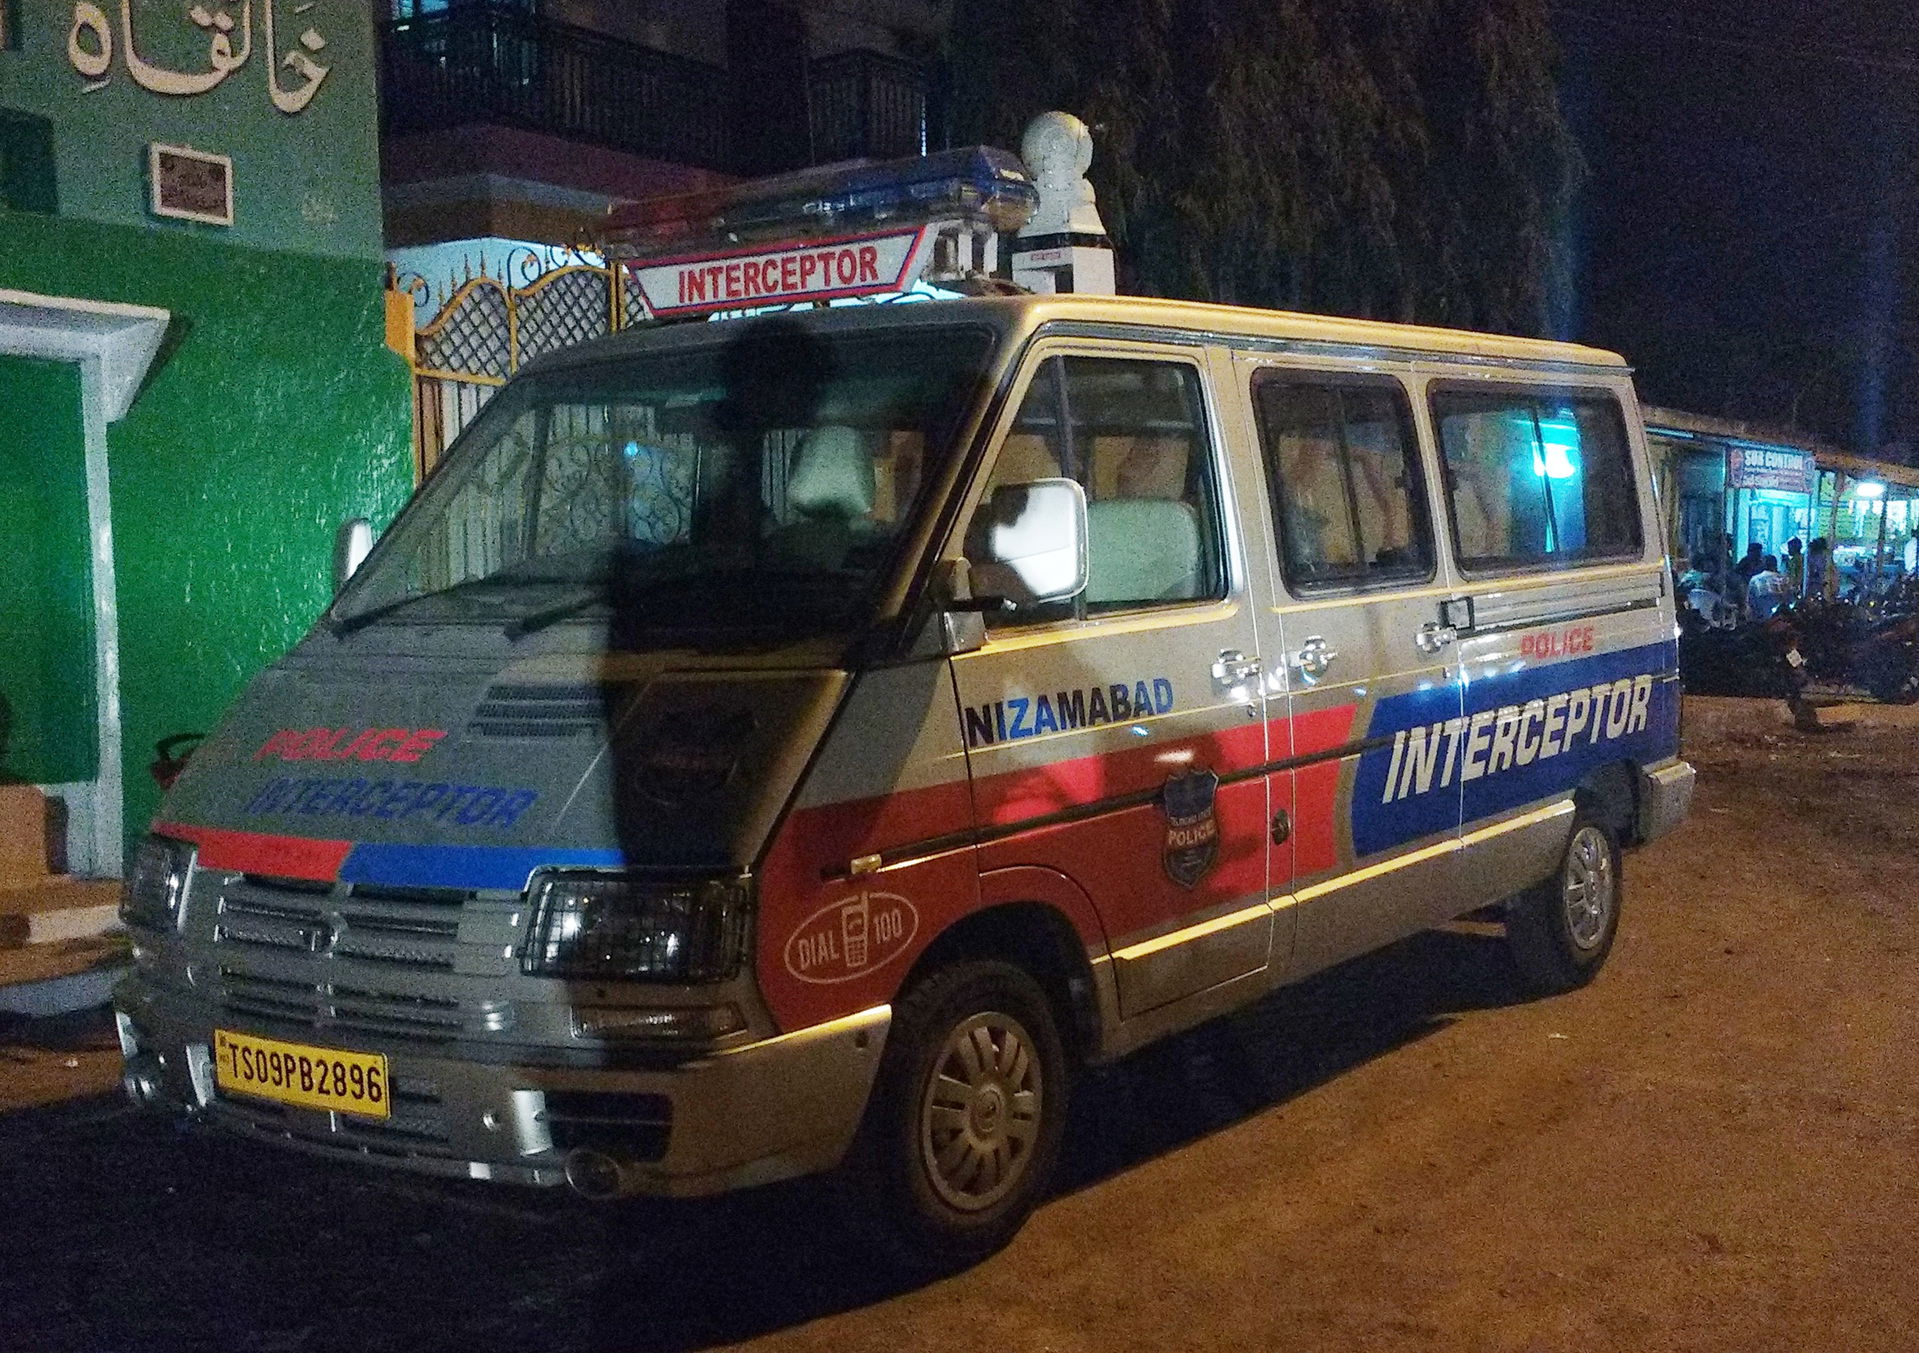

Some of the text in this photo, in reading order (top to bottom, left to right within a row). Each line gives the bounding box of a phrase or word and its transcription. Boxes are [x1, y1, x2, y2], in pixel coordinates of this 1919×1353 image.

[678, 245, 879, 303] INTERCEPTOR
[1519, 626, 1595, 660] POLICE
[964, 678, 1174, 748] NIZAMABAD
[1381, 674, 1653, 804] INTERCEPTOR
[252, 727, 449, 762] POLICE
[244, 777, 539, 829] INTERCEPTOR
[1168, 819, 1217, 846] POLICE
[798, 909, 902, 971] DIAL 100
[229, 1043, 383, 1103] TS09PB2896
